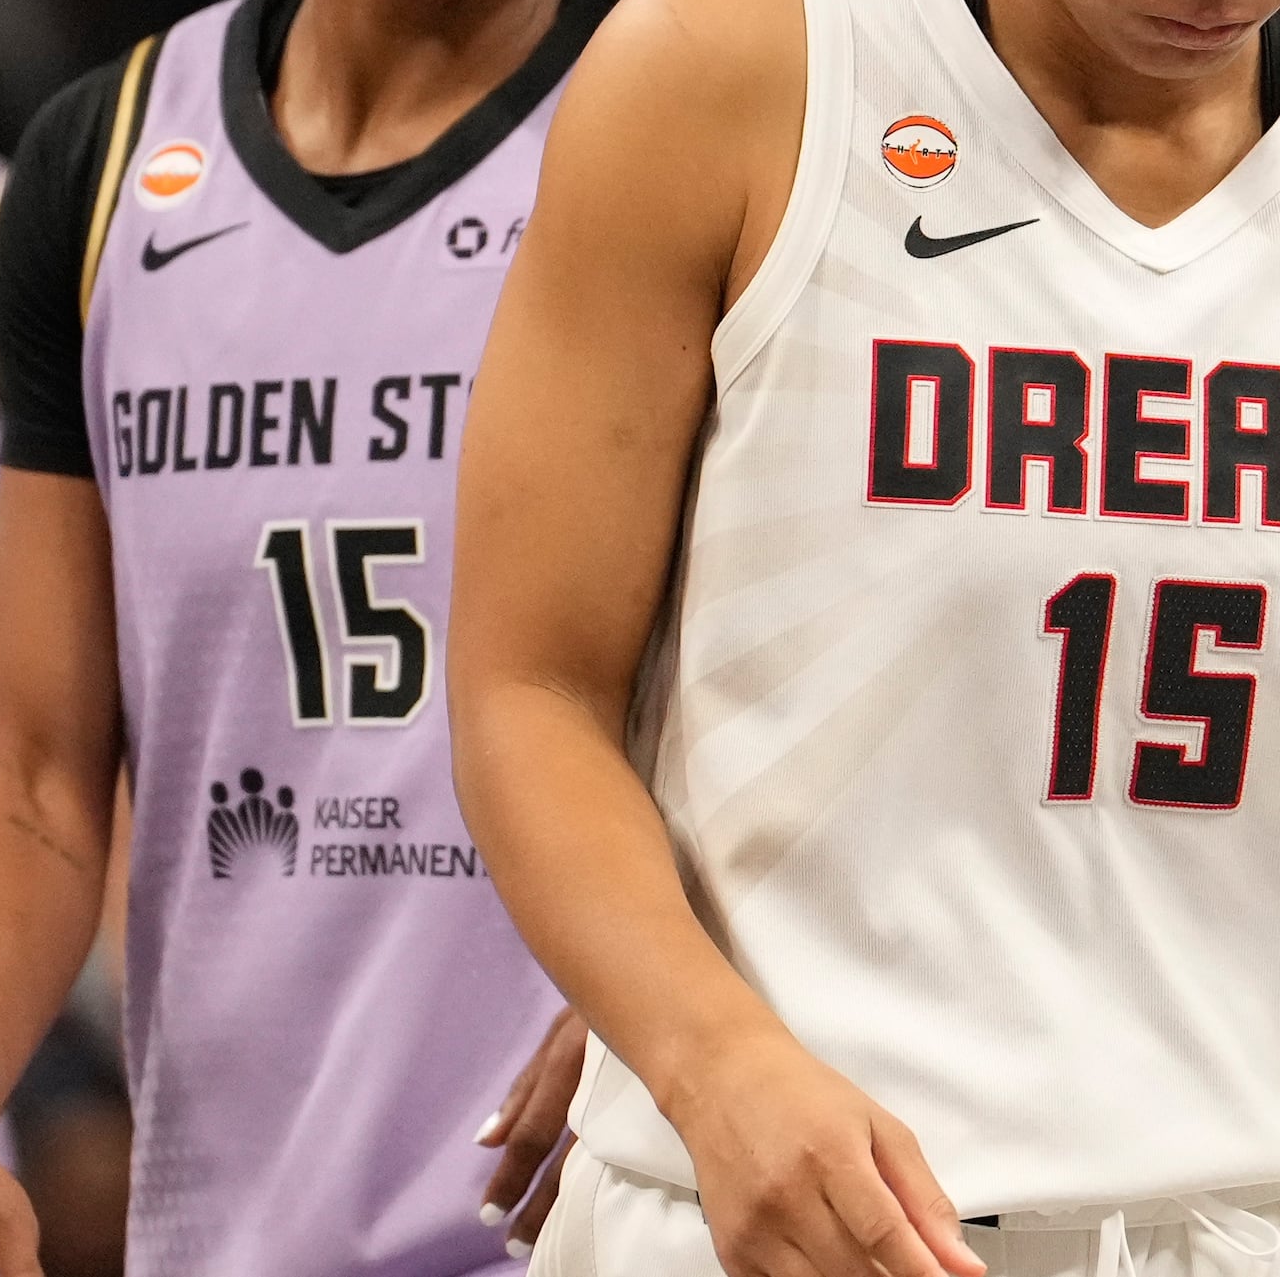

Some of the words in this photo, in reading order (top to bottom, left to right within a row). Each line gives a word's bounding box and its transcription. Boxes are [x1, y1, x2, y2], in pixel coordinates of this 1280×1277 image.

[112, 376, 337, 478] GOLDEN
[254, 519, 434, 727] 15
[1041, 572, 1269, 811] 15
[310, 844, 490, 878] PERMANEN
[314, 796, 401, 829] KAISER
